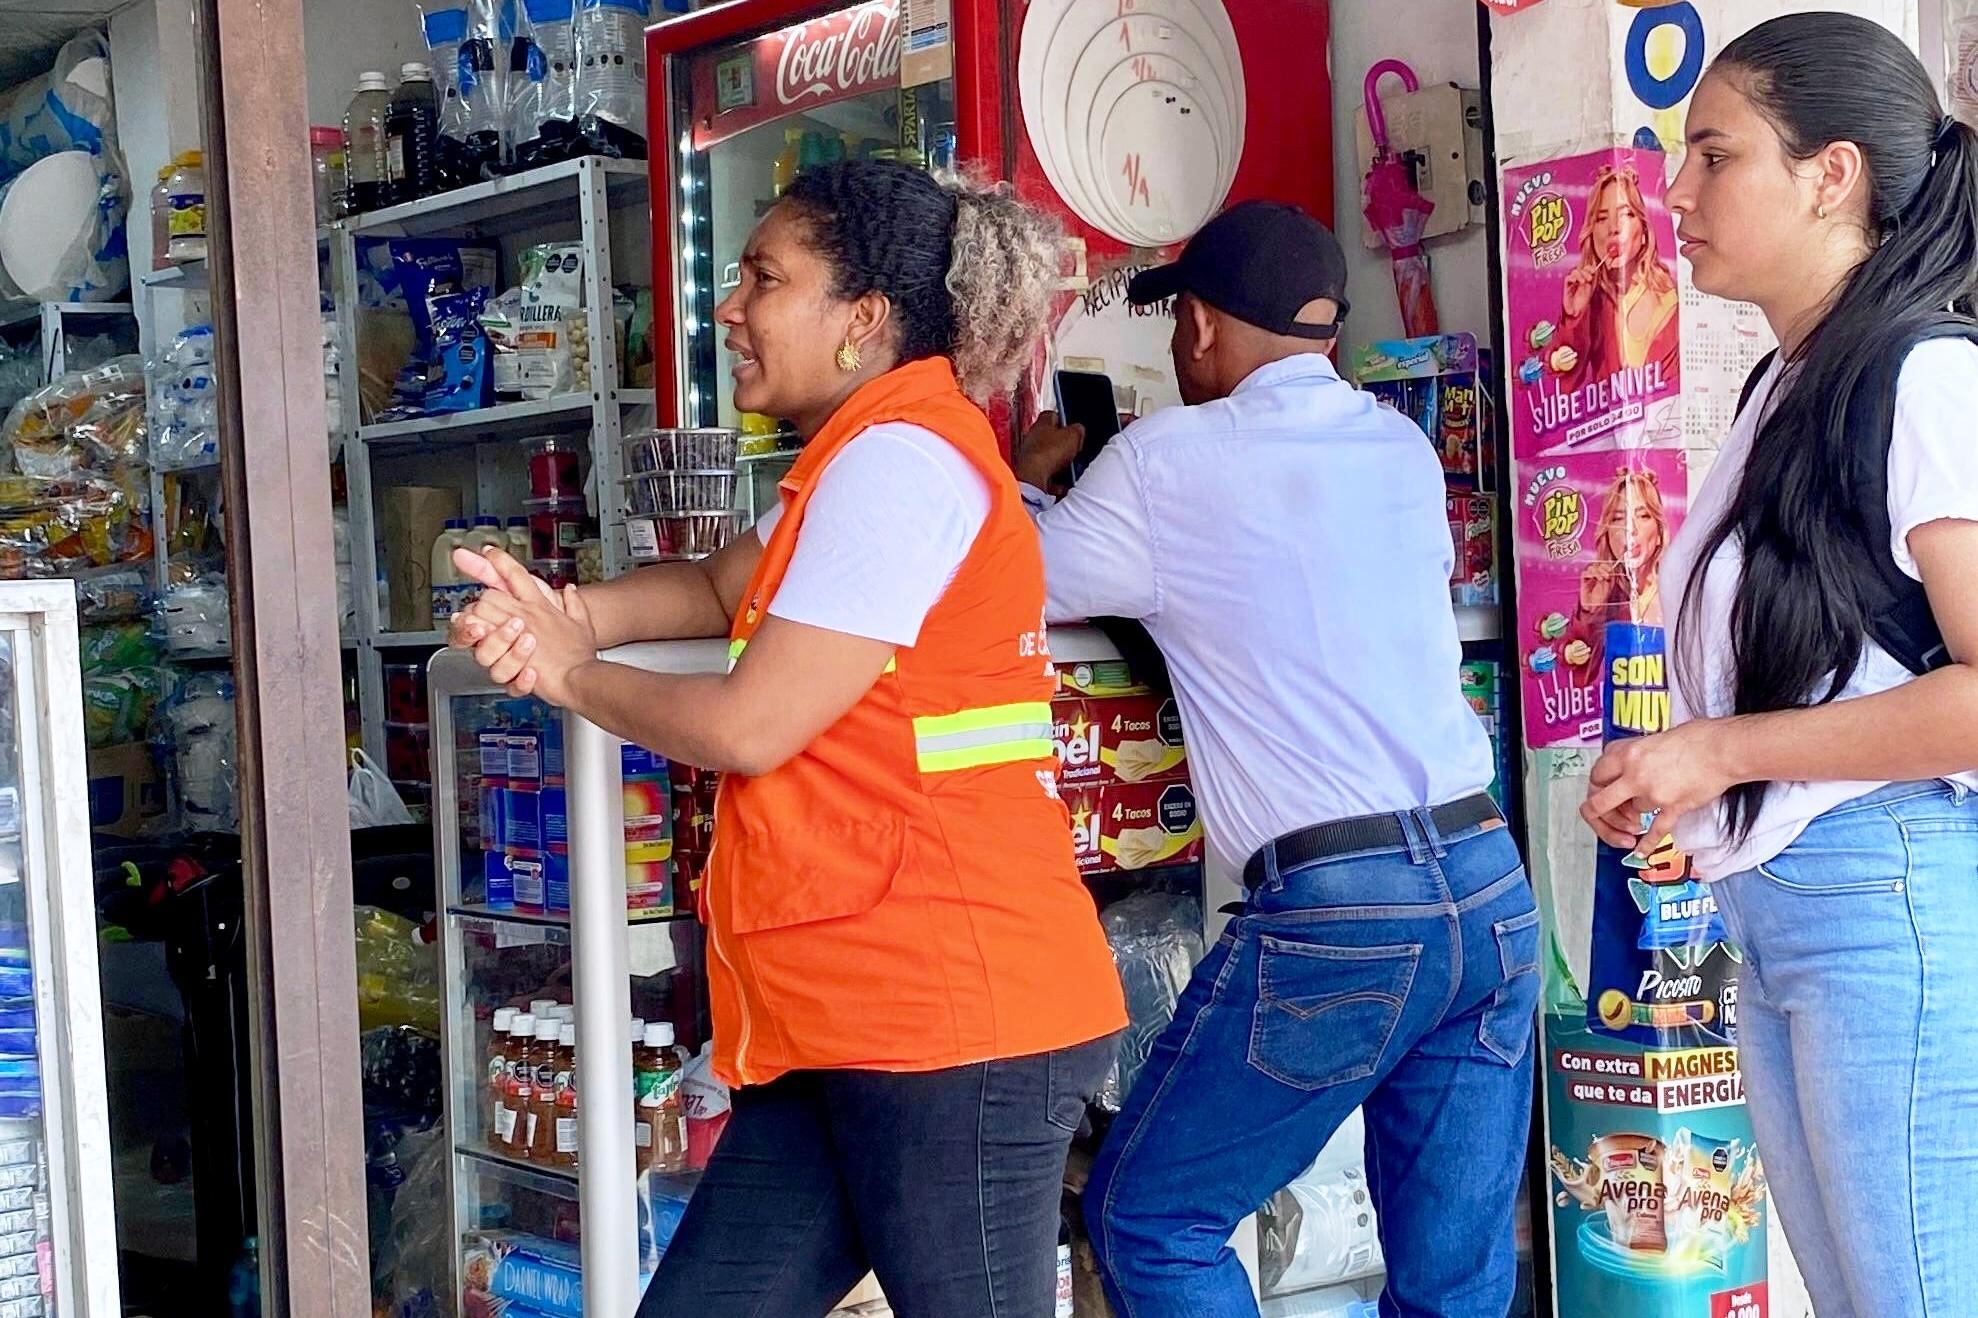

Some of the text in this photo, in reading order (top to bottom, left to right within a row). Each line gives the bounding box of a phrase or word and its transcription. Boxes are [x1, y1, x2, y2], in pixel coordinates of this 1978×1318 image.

[776, 2, 900, 105] Coca-Cola
[1511, 172, 1552, 217] NUEVO
[1531, 216, 1565, 248] POP
[520, 305, 562, 322] RDILLERA
[1528, 360, 1665, 434] SUBE DE NIVEL
[1569, 430, 1586, 441] POR
[1525, 466, 1566, 506] NUEVO
[1544, 511, 1579, 540] POP
[1019, 631, 1036, 657] DE
[1612, 653, 1665, 687] SON
[1538, 670, 1596, 724] SUBE
[1111, 713, 1151, 733] 4 Tacos
[1612, 689, 1670, 733] MUY
[1112, 802, 1152, 822] 4 Tacos
[1660, 899, 1701, 921] BLUE
[1561, 1050, 1736, 1080] Con extra MAGNES
[1573, 1083, 1604, 1101] que
[1607, 1084, 1626, 1101] te
[1630, 1086, 1653, 1104] da
[1599, 1178, 1668, 1205] Avena
[1627, 1197, 1659, 1213] pro
[1676, 1186, 1730, 1212] Avena
[1700, 1207, 1722, 1225] pro
